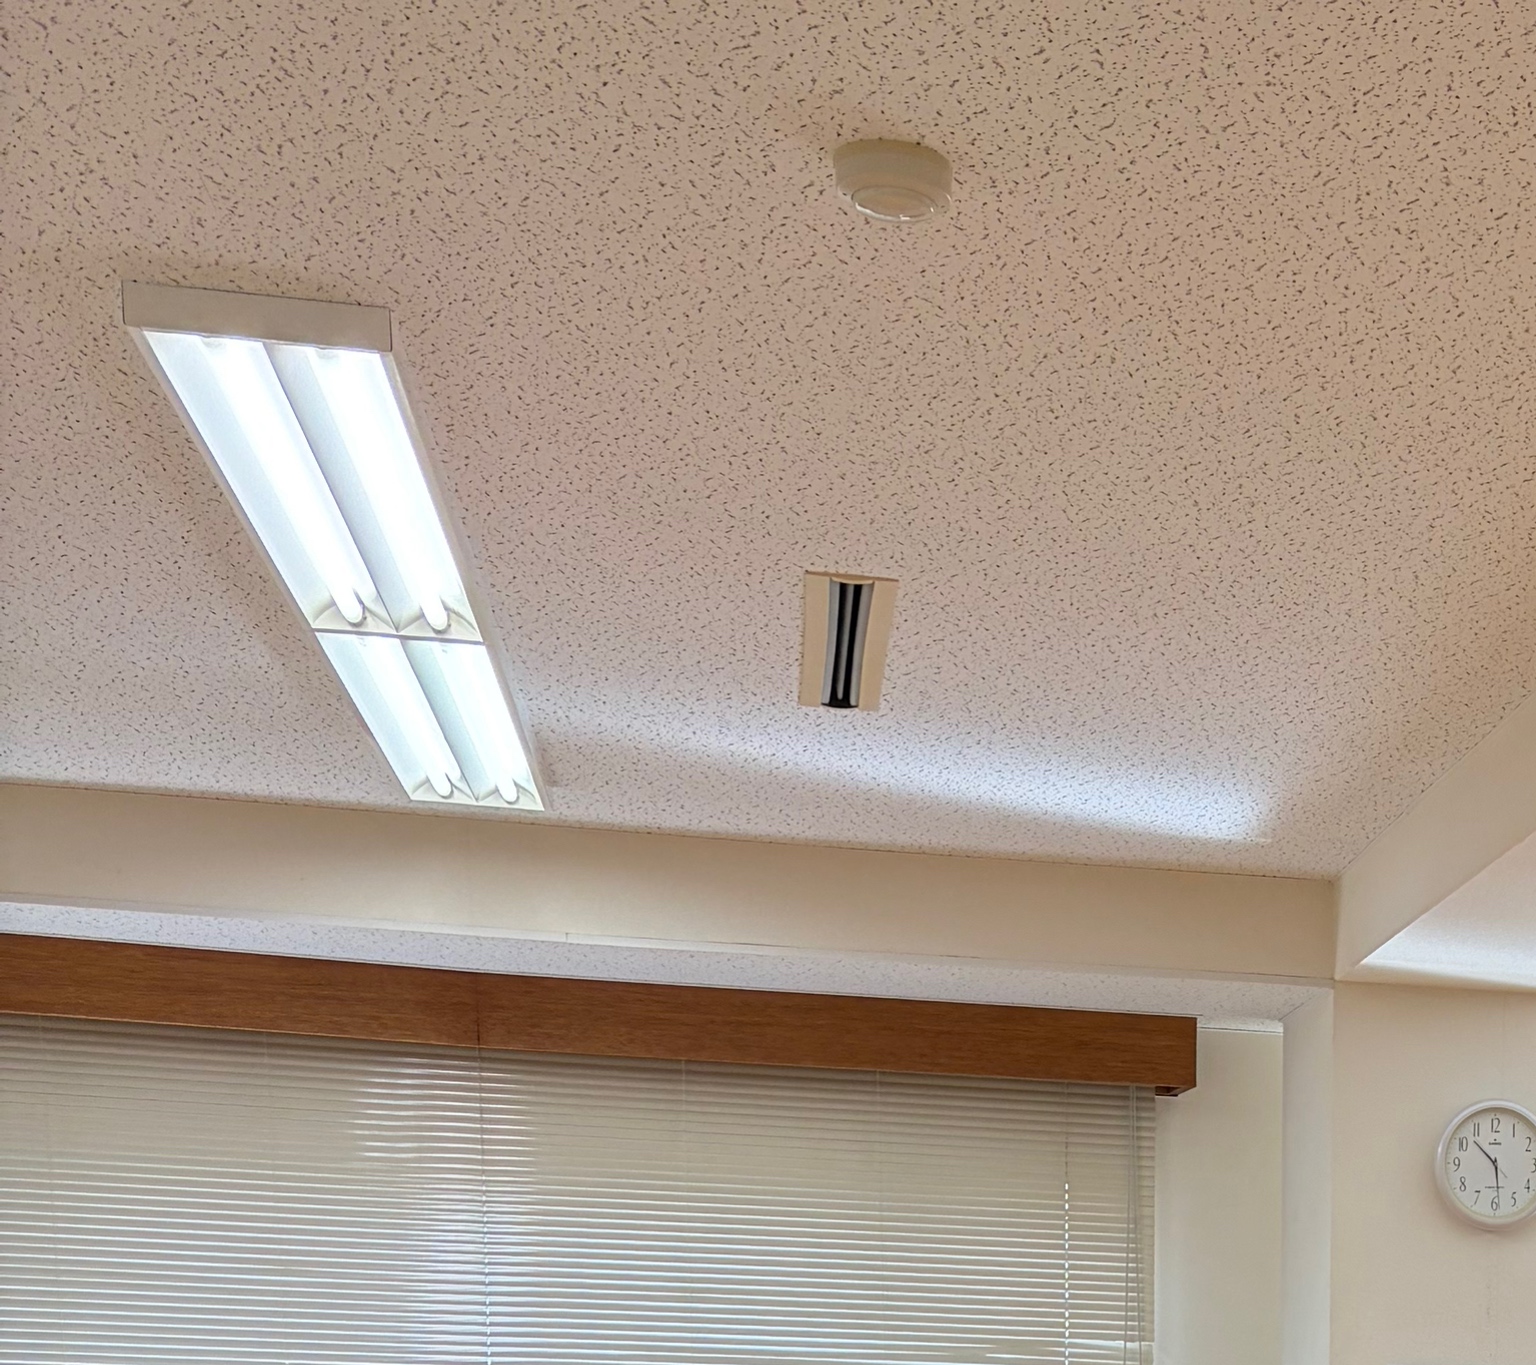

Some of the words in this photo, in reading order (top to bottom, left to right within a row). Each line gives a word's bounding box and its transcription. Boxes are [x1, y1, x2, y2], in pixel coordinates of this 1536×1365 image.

[1473, 1122, 1480, 1137] 11
[1491, 1118, 1500, 1133] 12
[1512, 1123, 1515, 1138] 1
[1458, 1136, 1468, 1152] 10
[1525, 1137, 1532, 1152] 2
[1453, 1157, 1460, 1172] 9
[1459, 1176, 1466, 1192] 8
[1524, 1177, 1530, 1193] 4
[1474, 1190, 1481, 1205] 7
[1491, 1195, 1498, 1211] 6
[1511, 1192, 1517, 1207] 5
